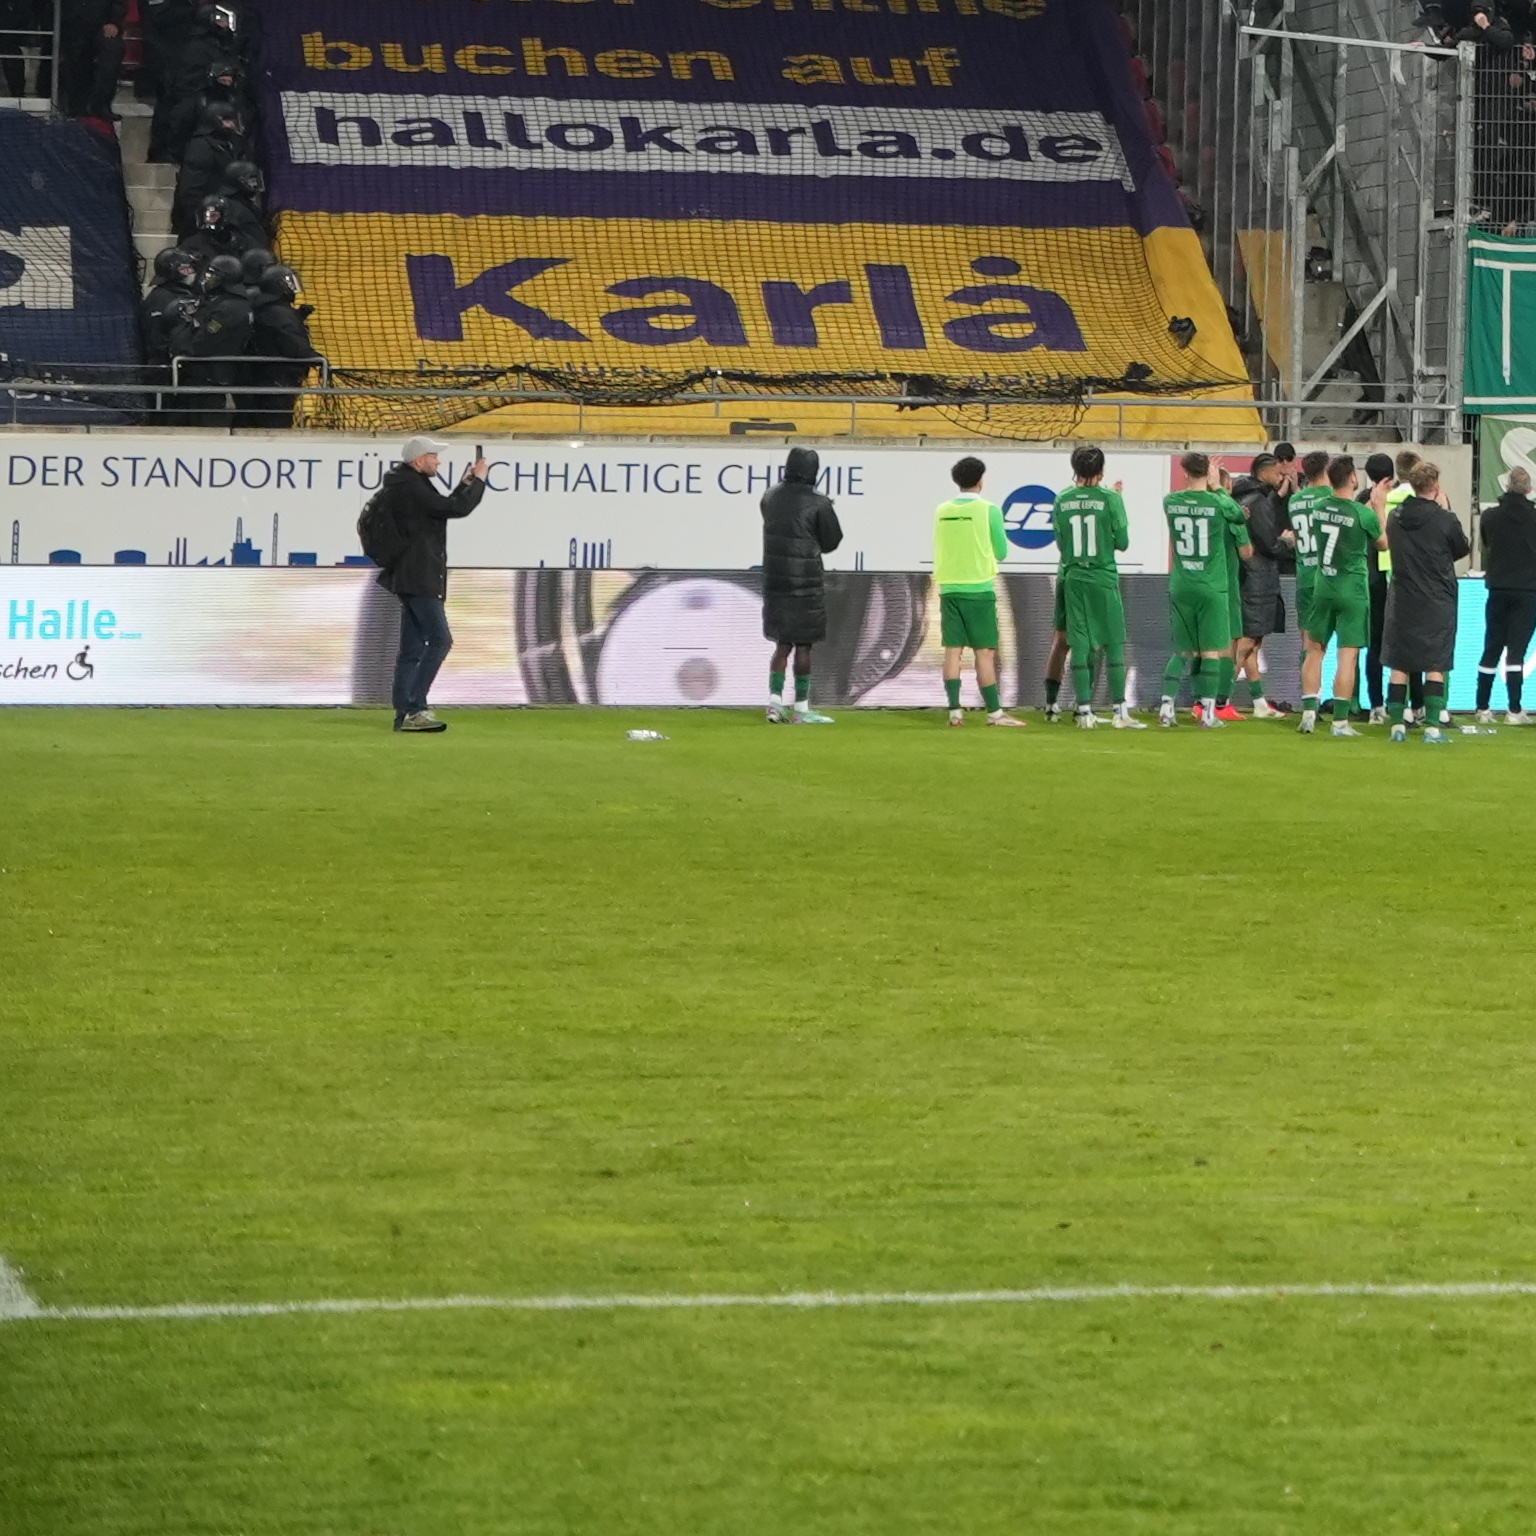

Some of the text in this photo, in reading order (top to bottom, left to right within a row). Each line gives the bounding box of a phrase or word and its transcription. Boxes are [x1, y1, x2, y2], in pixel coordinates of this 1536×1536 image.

[300, 30, 961, 87] buchen auf
[313, 104, 1104, 165] hallokarla.de
[8, 455, 85, 487] DER
[100, 456, 322, 490] STANDORT
[1068, 514, 1098, 557] 11
[1173, 517, 1210, 557] 31
[1320, 524, 1341, 565] 7
[8, 599, 117, 640] Halle
